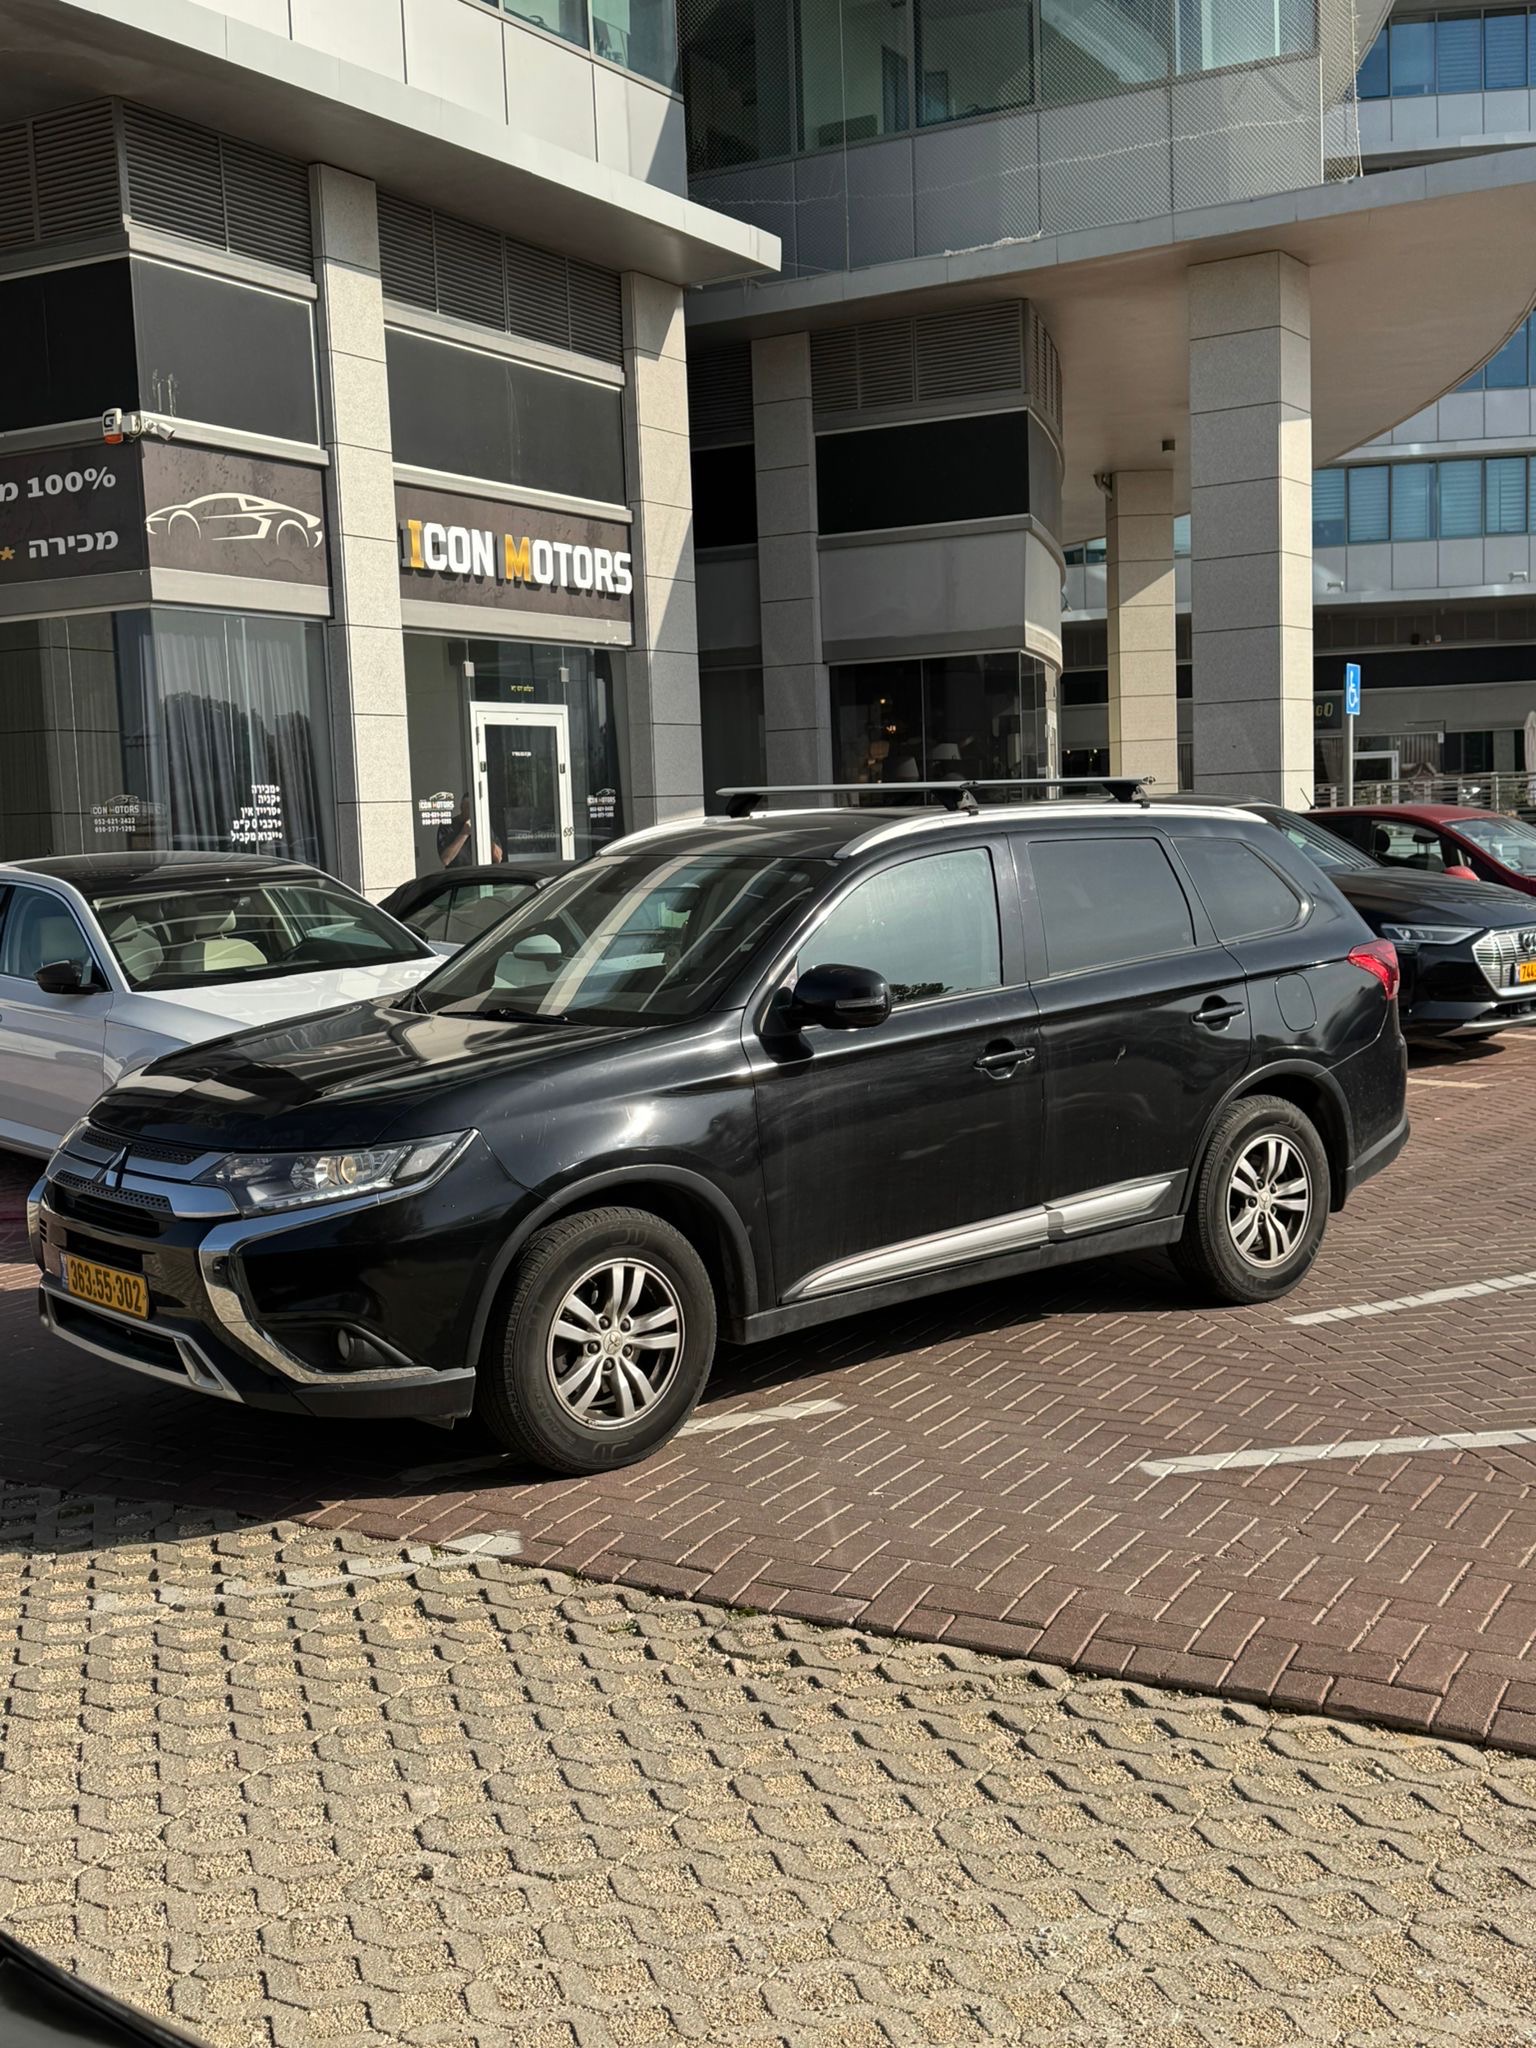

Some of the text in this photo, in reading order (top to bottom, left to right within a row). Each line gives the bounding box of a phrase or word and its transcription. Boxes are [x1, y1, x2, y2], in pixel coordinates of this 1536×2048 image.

[27, 466, 116, 498] 100%
[28, 529, 119, 559] מכירה
[407, 519, 633, 595] ICON MOTORS
